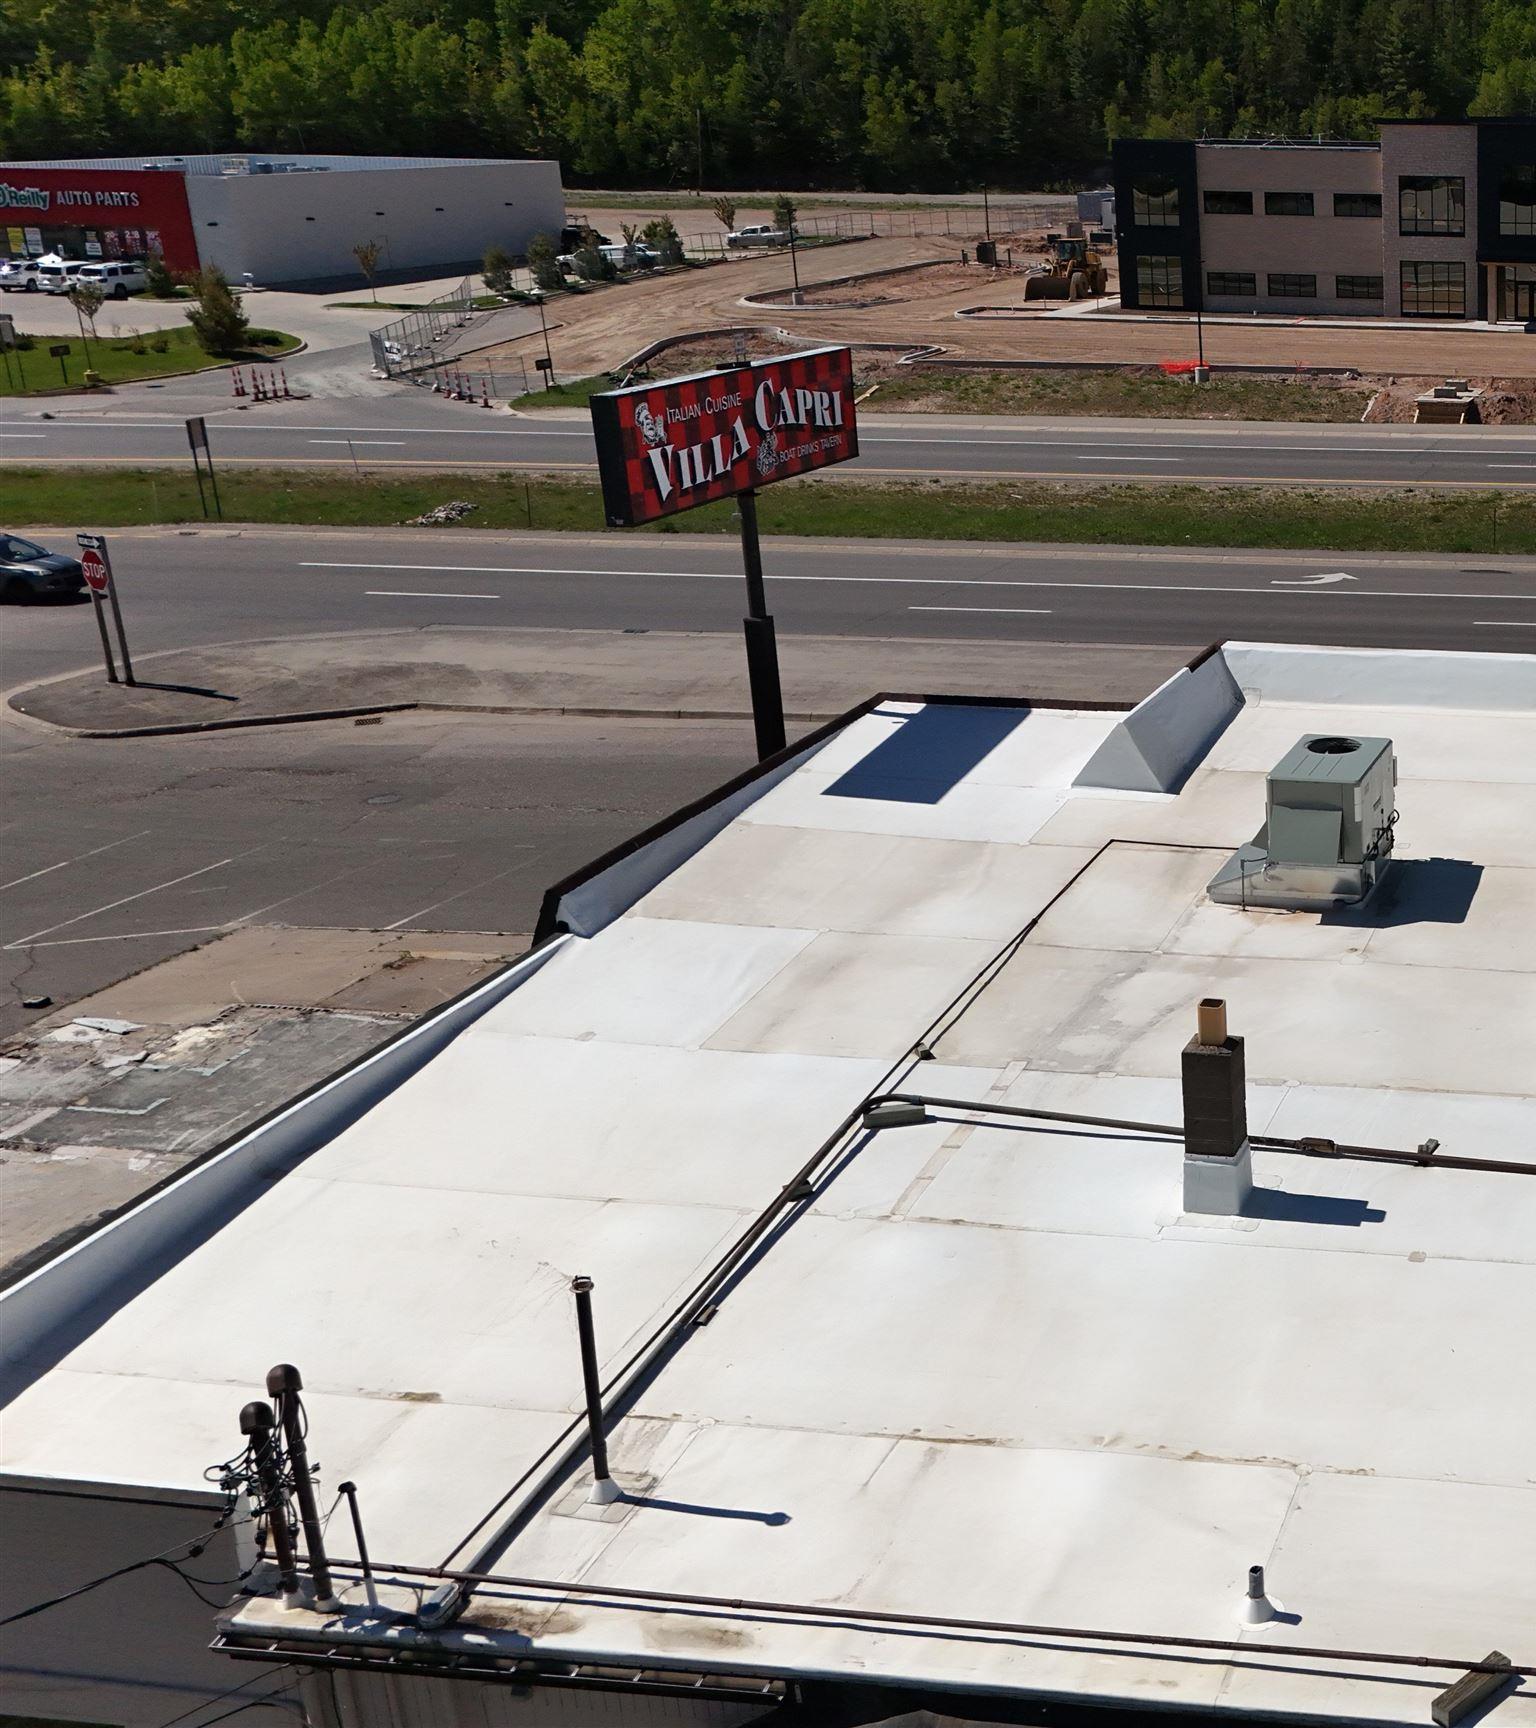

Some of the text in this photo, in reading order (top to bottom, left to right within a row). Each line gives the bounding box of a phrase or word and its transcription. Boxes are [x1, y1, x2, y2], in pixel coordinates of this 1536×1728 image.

[57, 190, 92, 206] AUTO
[95, 191, 139, 207] PARTS
[666, 392, 742, 425] ITALIAN CUISINE
[647, 378, 843, 501] VILLA CAPRI
[83, 561, 106, 579] STOP
